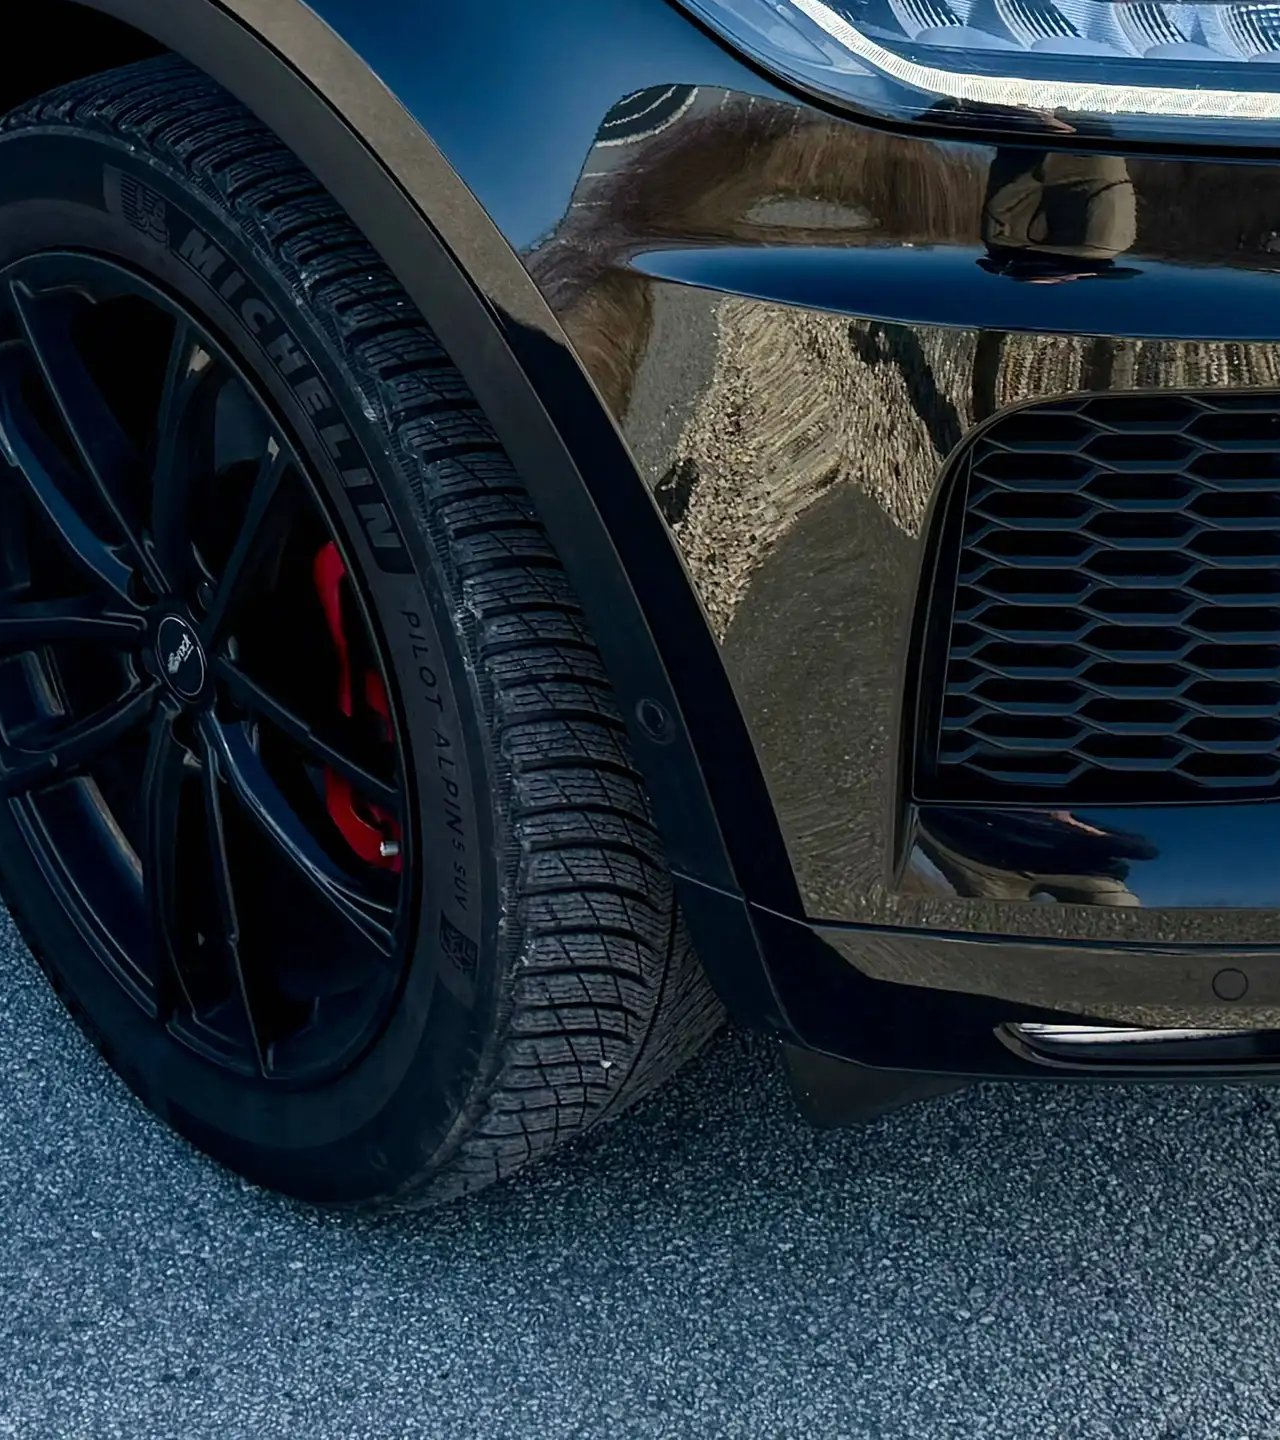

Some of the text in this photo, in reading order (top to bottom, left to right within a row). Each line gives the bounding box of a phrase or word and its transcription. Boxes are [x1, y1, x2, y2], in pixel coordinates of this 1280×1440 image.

[177, 228, 404, 550] MICHELIN
[400, 609, 444, 714] PILOT
[431, 727, 464, 836] ALPIN
[451, 860, 469, 912] SUV
